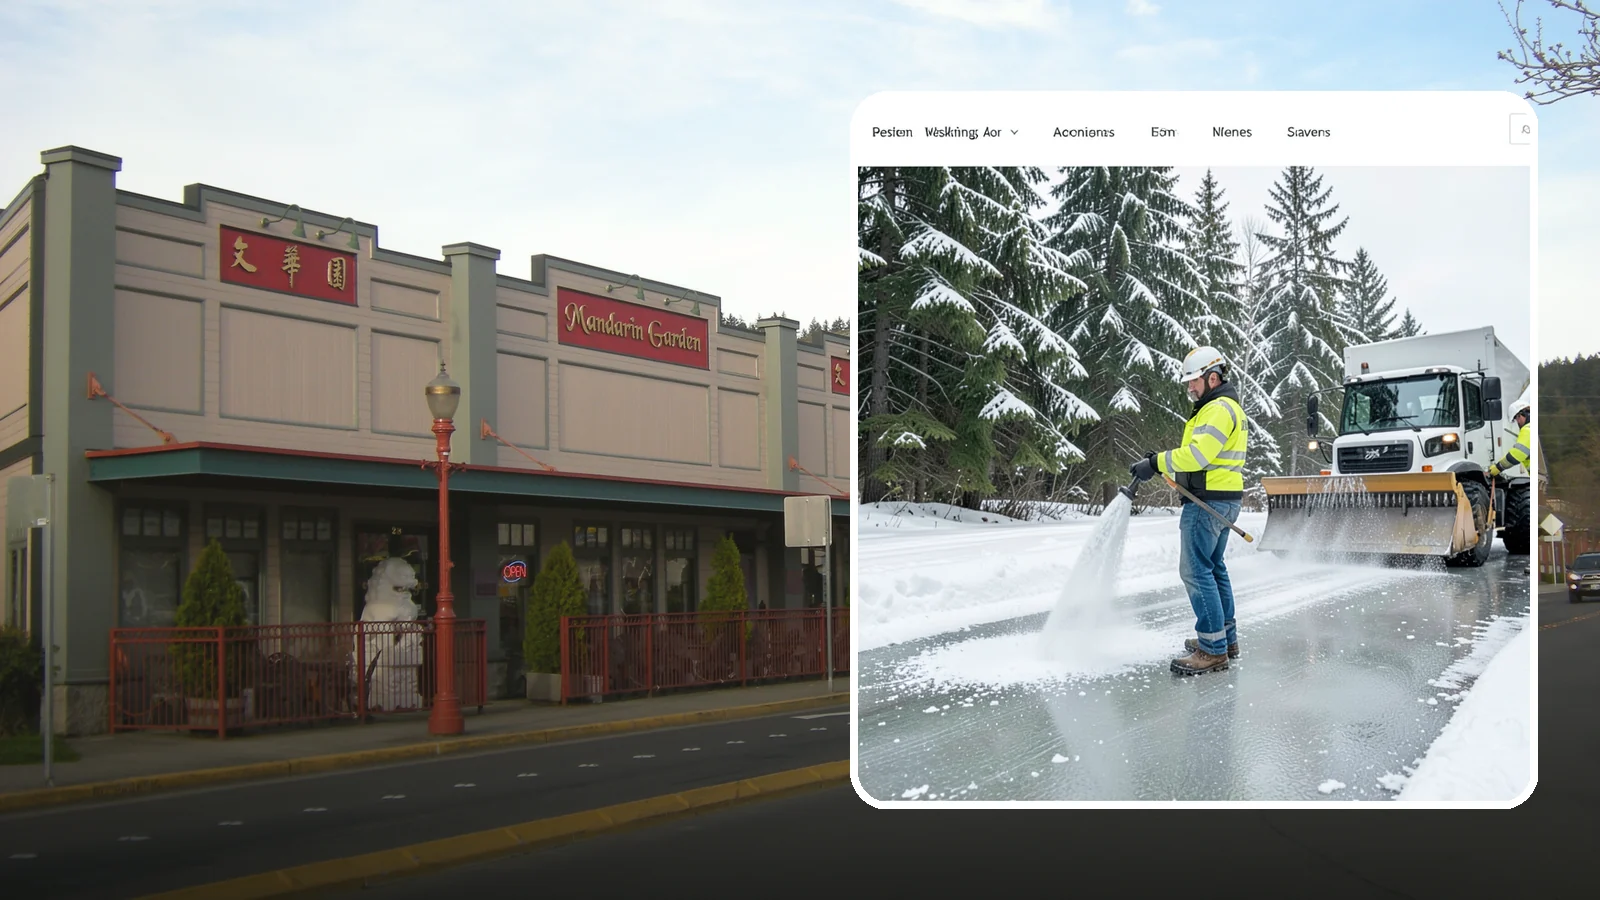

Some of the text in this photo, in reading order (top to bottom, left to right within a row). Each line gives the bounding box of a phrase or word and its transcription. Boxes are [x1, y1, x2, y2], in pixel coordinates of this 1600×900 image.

[564, 302, 701, 352] Mandarin Garden
[503, 565, 527, 578] OPEN
